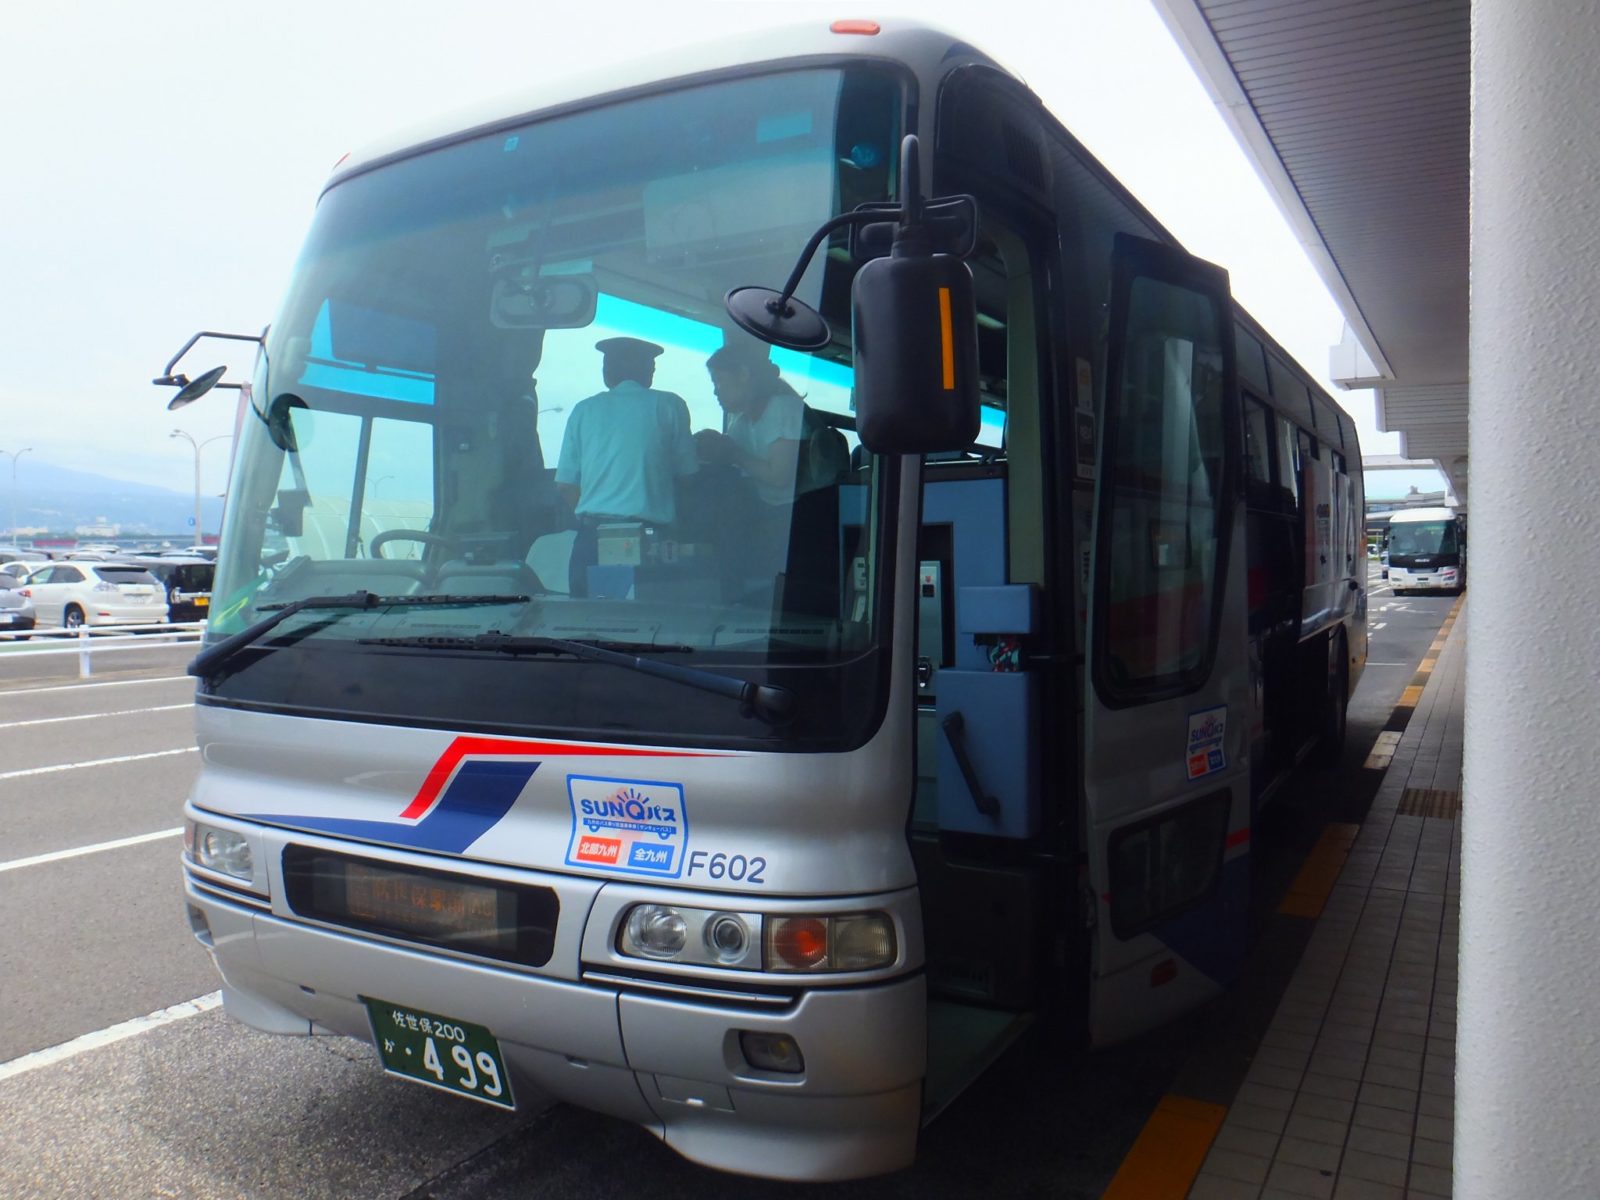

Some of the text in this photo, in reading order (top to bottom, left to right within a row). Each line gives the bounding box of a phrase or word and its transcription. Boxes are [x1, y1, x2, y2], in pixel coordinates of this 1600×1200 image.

[580, 841, 617, 857] 北部九州
[633, 847, 668, 864] 全九州
[687, 850, 767, 884] F602
